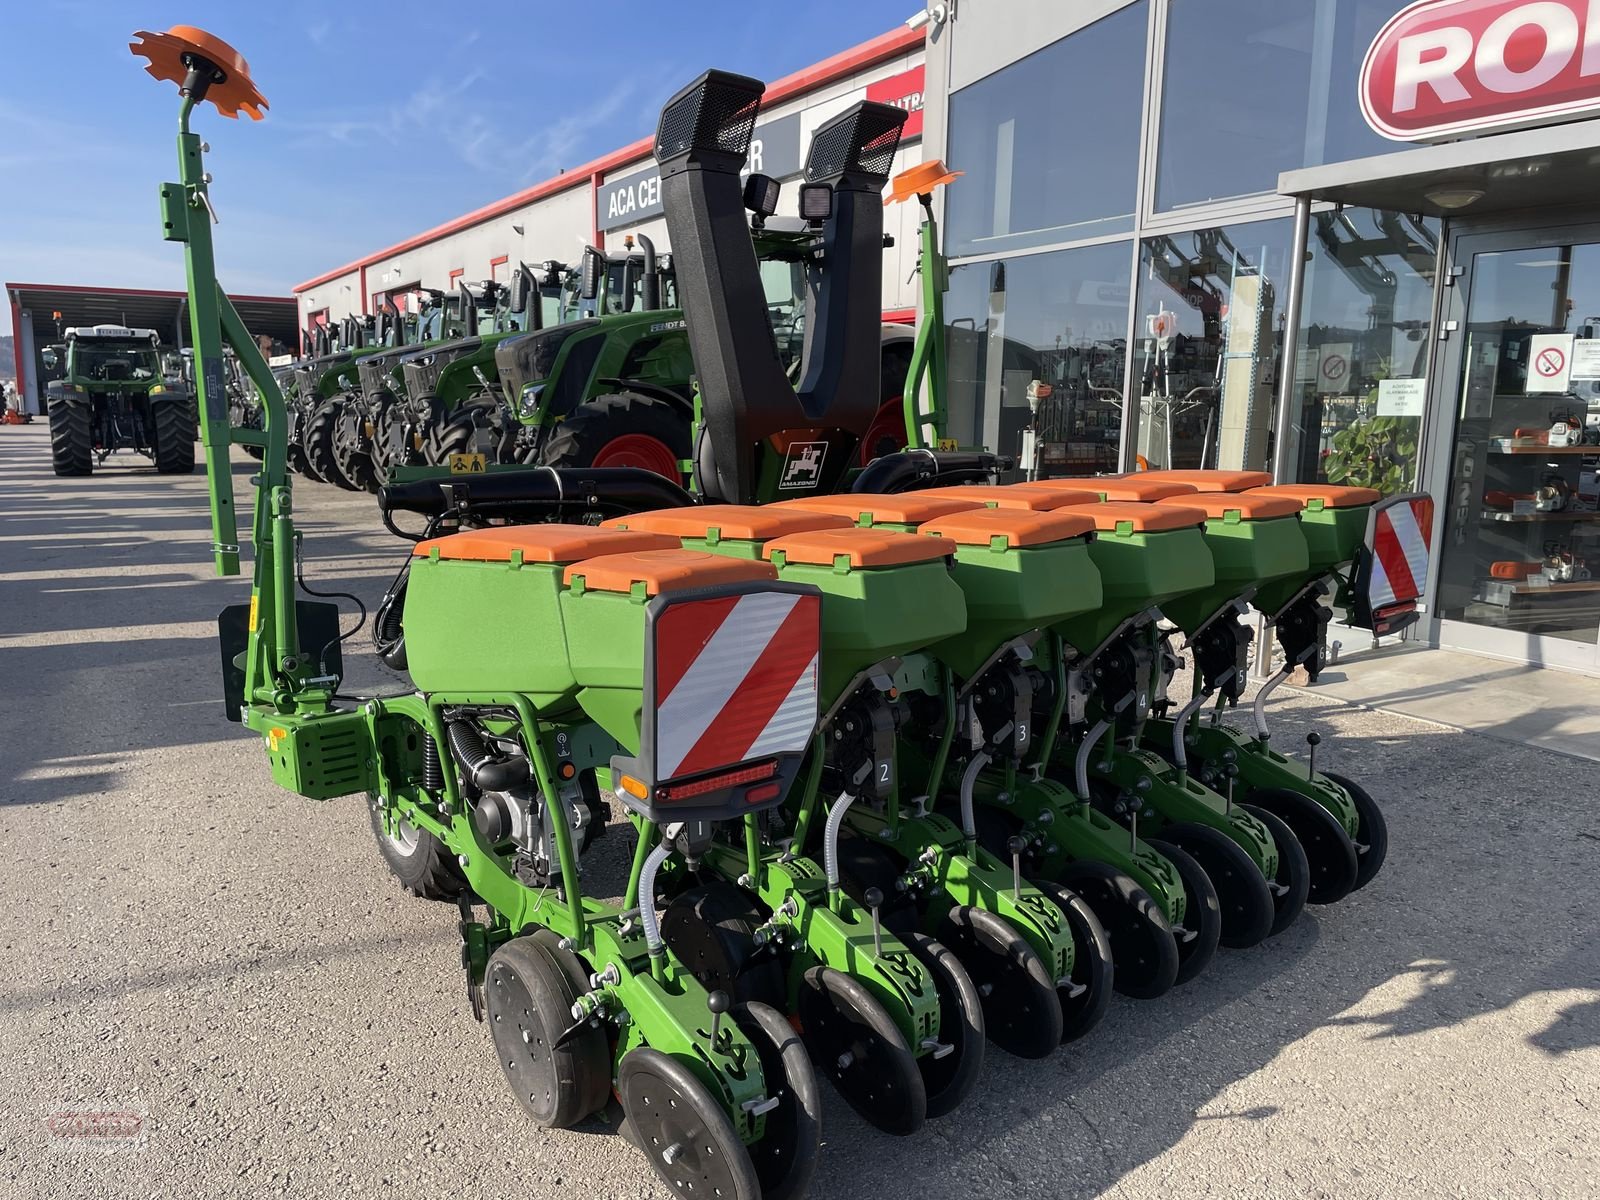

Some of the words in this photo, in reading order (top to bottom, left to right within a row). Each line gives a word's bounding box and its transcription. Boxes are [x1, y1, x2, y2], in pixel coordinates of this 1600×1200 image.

[1392, 0, 1600, 114] RO
[608, 185, 636, 219] ACA
[650, 321, 678, 333] FENDT
[1319, 647, 1325, 660] 6
[1239, 669, 1244, 683] 5
[1139, 694, 1146, 708] 4
[1019, 725, 1026, 741] 3
[880, 763, 889, 782] 2
